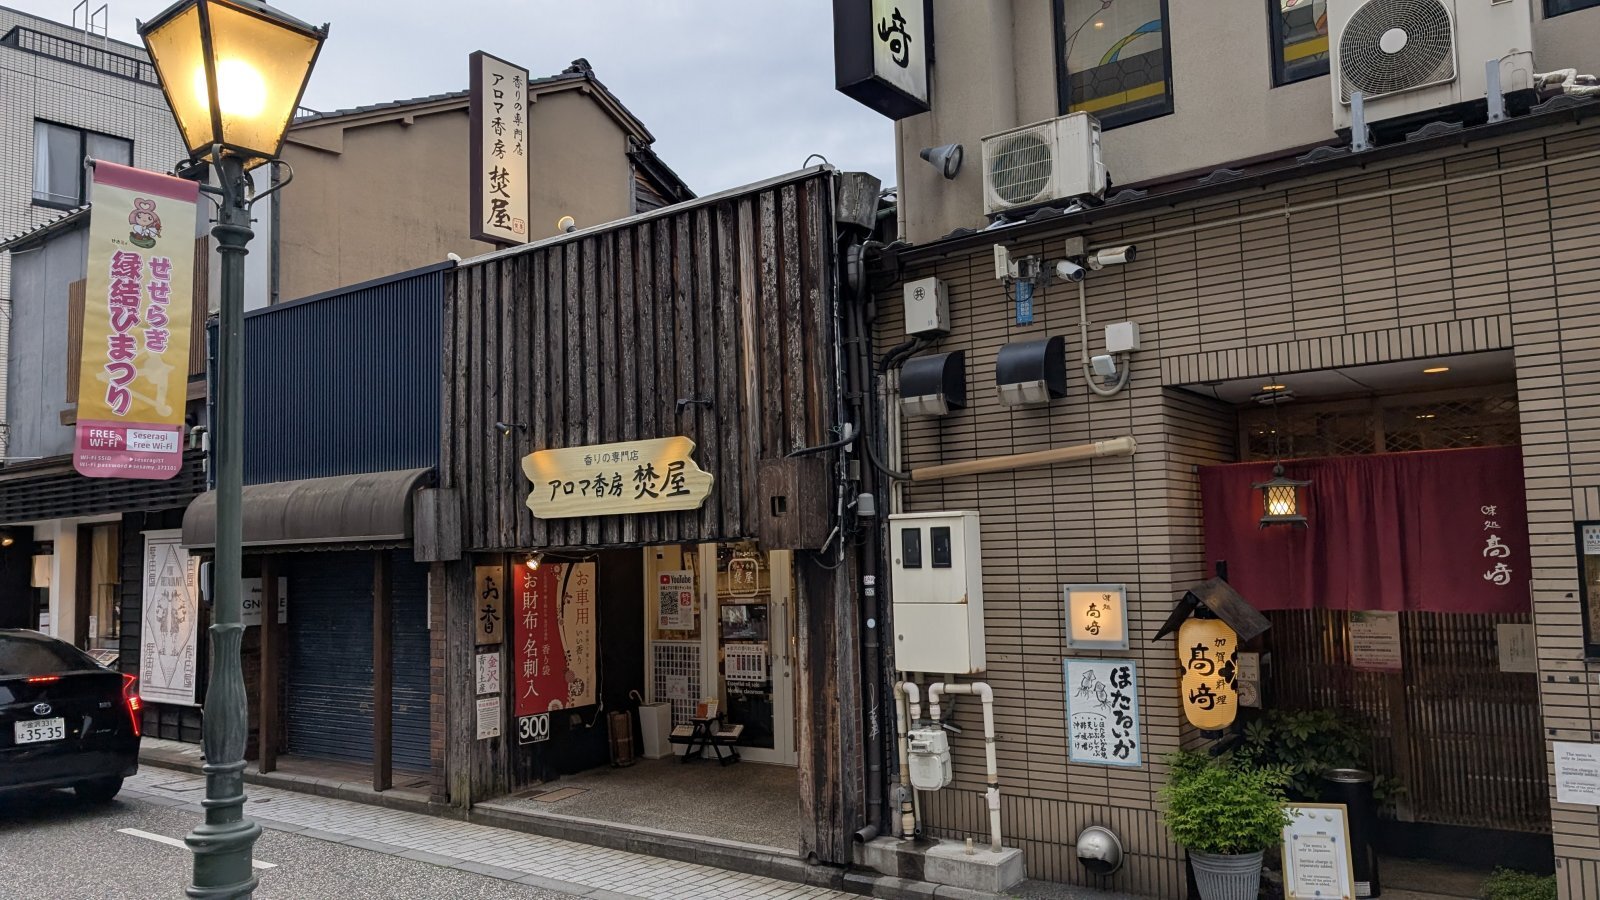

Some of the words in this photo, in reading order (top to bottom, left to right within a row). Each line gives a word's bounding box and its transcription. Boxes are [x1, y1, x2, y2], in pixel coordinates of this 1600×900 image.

[491, 73, 507, 160] アロマ香房
[512, 75, 523, 157] 香りの専門店
[487, 165, 512, 232] 焚屋
[145, 257, 172, 353] せせらぎ
[105, 251, 143, 416] 縁結びまつり
[90, 429, 115, 438] FREE
[90, 439, 118, 448] Wi-Fi
[133, 432, 168, 441] Seseragi
[584, 450, 640, 466] 香りの専門店
[548, 472, 624, 501] アロマ香房
[632, 460, 690, 500] 焚屋
[576, 570, 589, 626] お車用
[671, 575, 691, 584] YouTube
[480, 576, 500, 634] お香
[523, 572, 539, 699] お財布・名刺入
[576, 630, 584, 665] いい香り
[487, 655, 498, 690] 金沢の
[26, 726, 62, 741] 35-35
[520, 715, 548, 739] 300
[1110, 666, 1136, 760] ほたるいか
